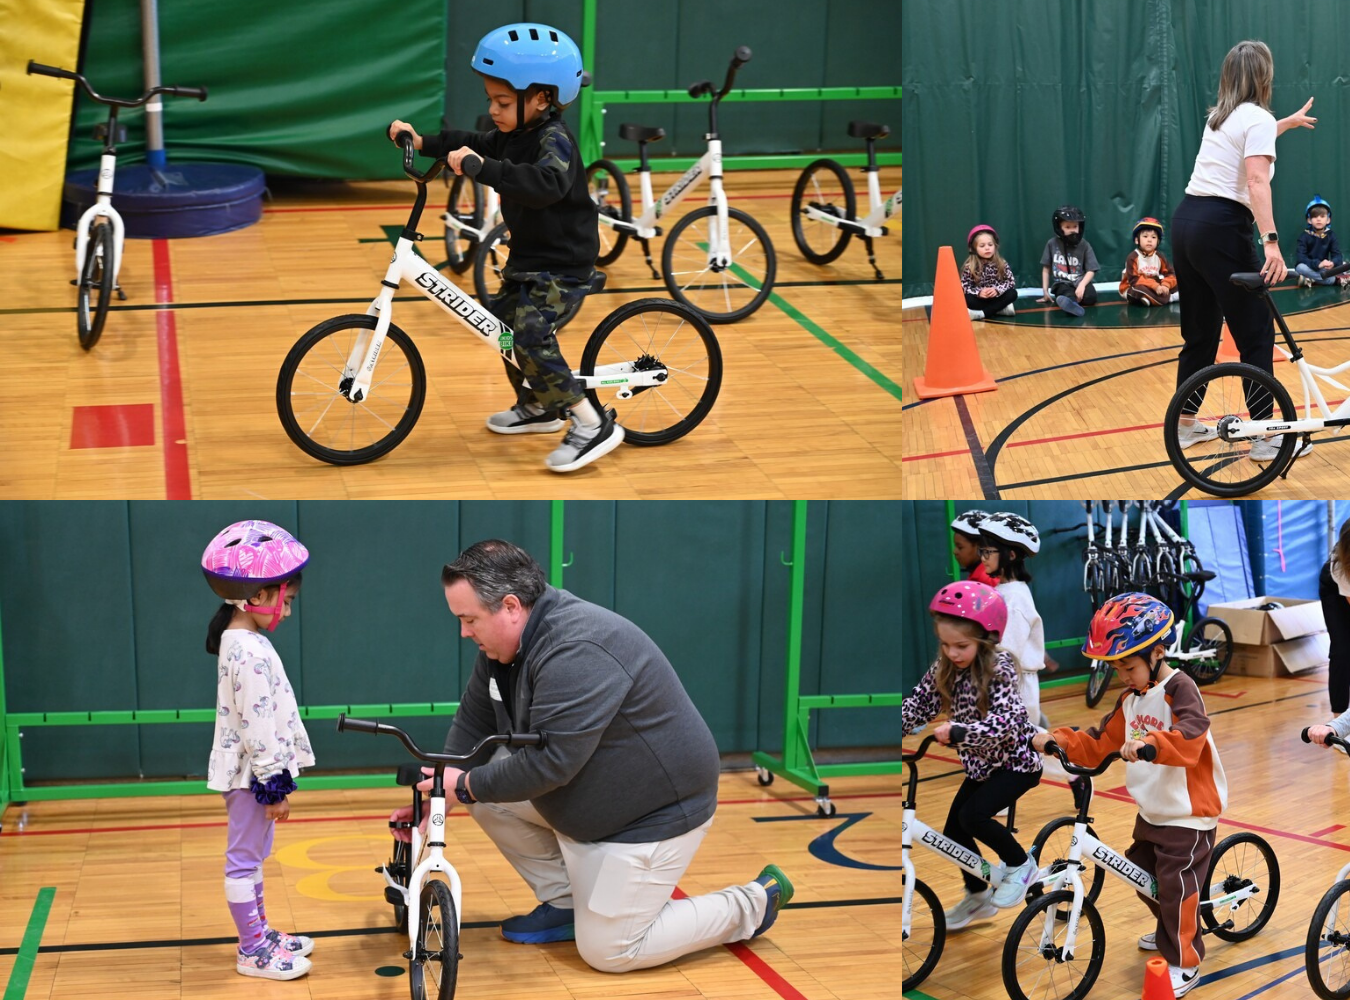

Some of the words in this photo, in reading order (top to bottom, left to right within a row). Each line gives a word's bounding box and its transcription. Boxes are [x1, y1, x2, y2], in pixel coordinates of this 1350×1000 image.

[415, 271, 498, 337] STRIDER
[921, 830, 979, 869] STRIDER
[1092, 846, 1150, 888] STRIDER
